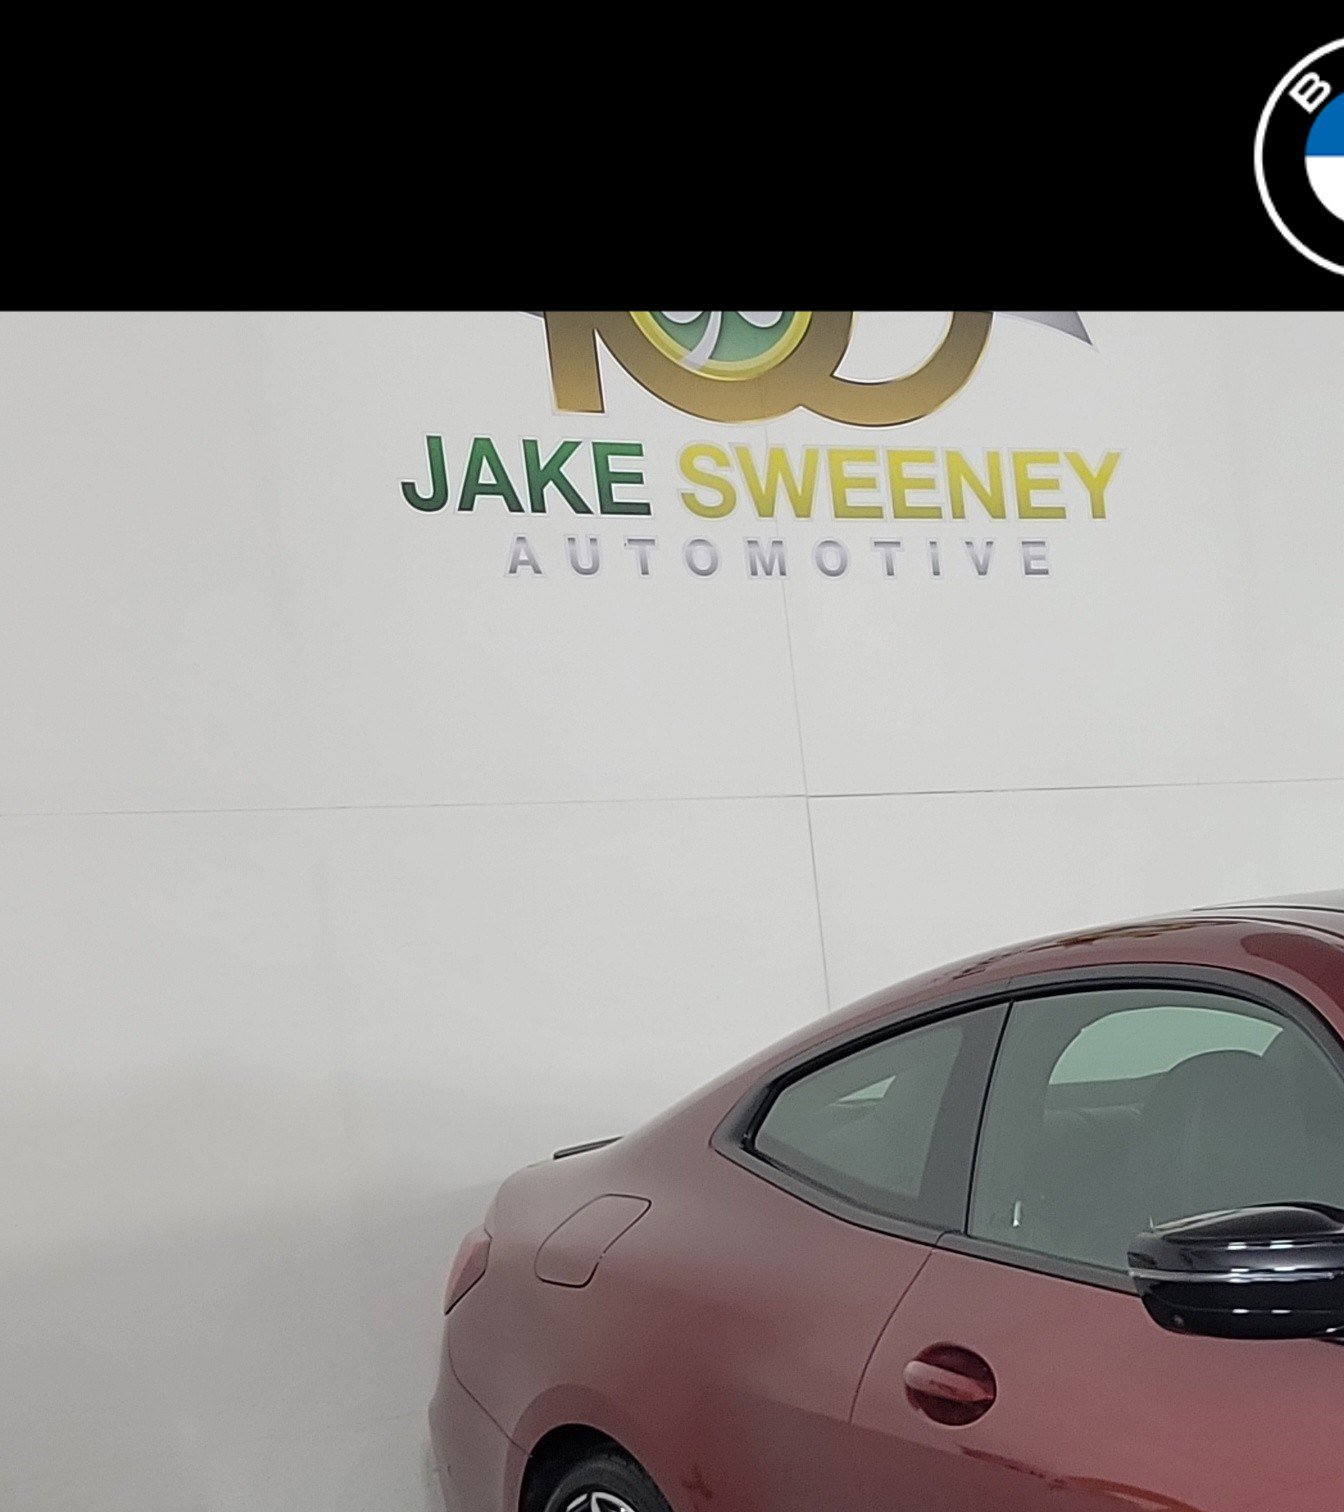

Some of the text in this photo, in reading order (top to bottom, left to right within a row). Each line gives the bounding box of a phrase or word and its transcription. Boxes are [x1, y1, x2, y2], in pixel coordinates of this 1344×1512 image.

[401, 435, 1121, 519] JAKE SWEENEY
[508, 536, 1050, 576] AUTOMOTIVE
